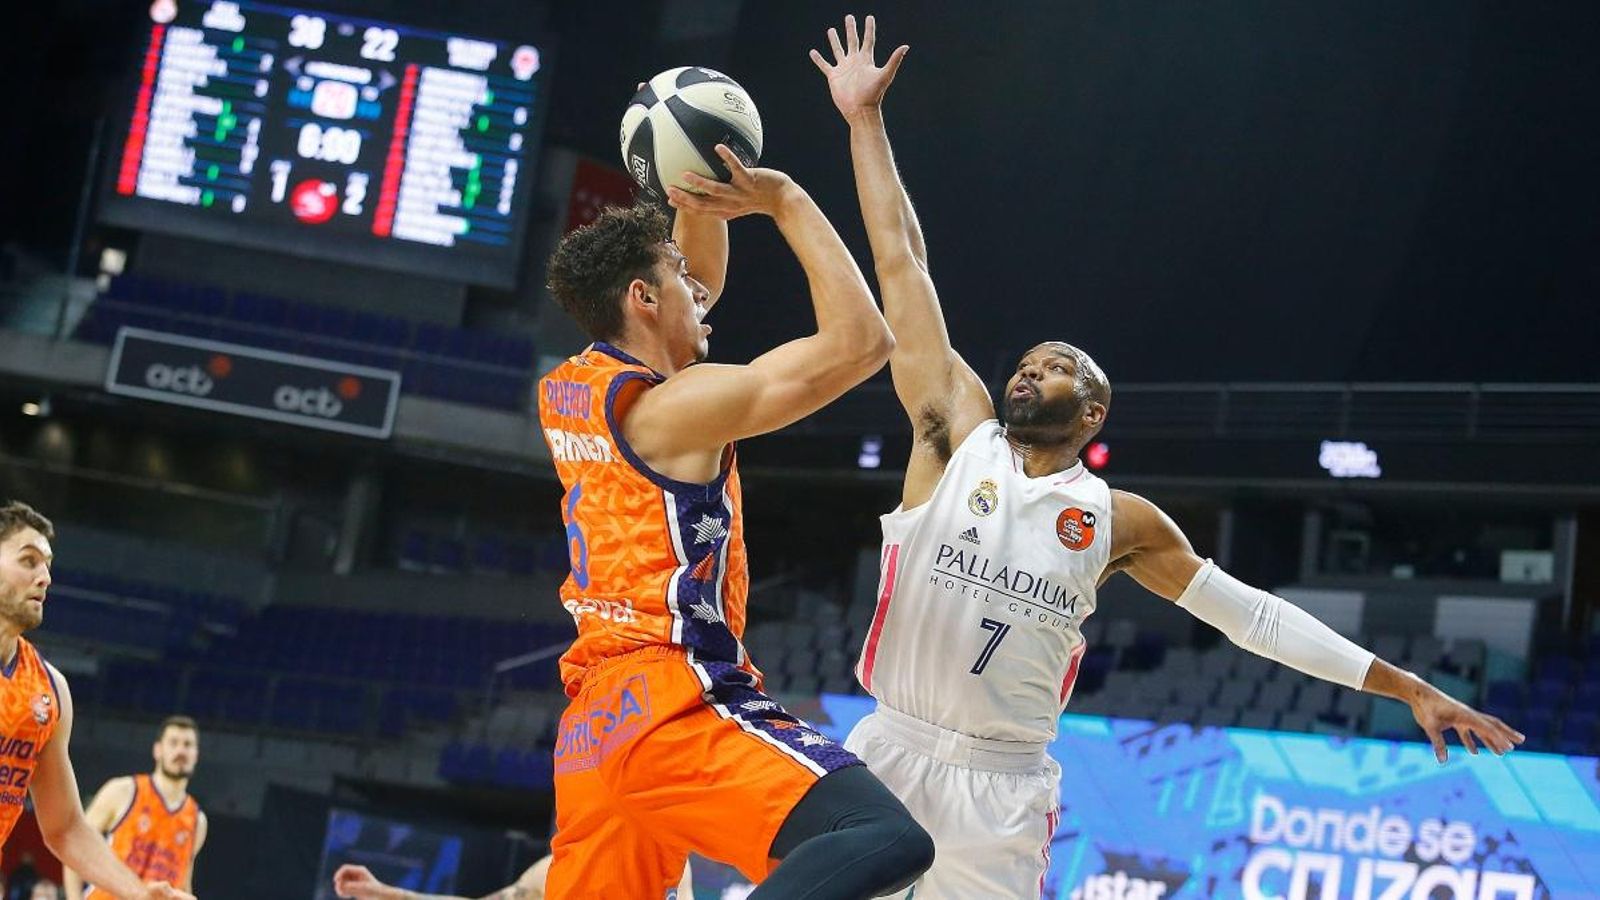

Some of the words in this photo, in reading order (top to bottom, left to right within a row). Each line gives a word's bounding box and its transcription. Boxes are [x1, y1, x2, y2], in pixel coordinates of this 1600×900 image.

[362, 27, 398, 61] 22
[929, 575, 991, 603] HOTEL
[935, 544, 1079, 614] PALLADIUM
[969, 617, 1011, 675] 7
[1250, 794, 1412, 857] Donde
[1415, 817, 1475, 864] se
